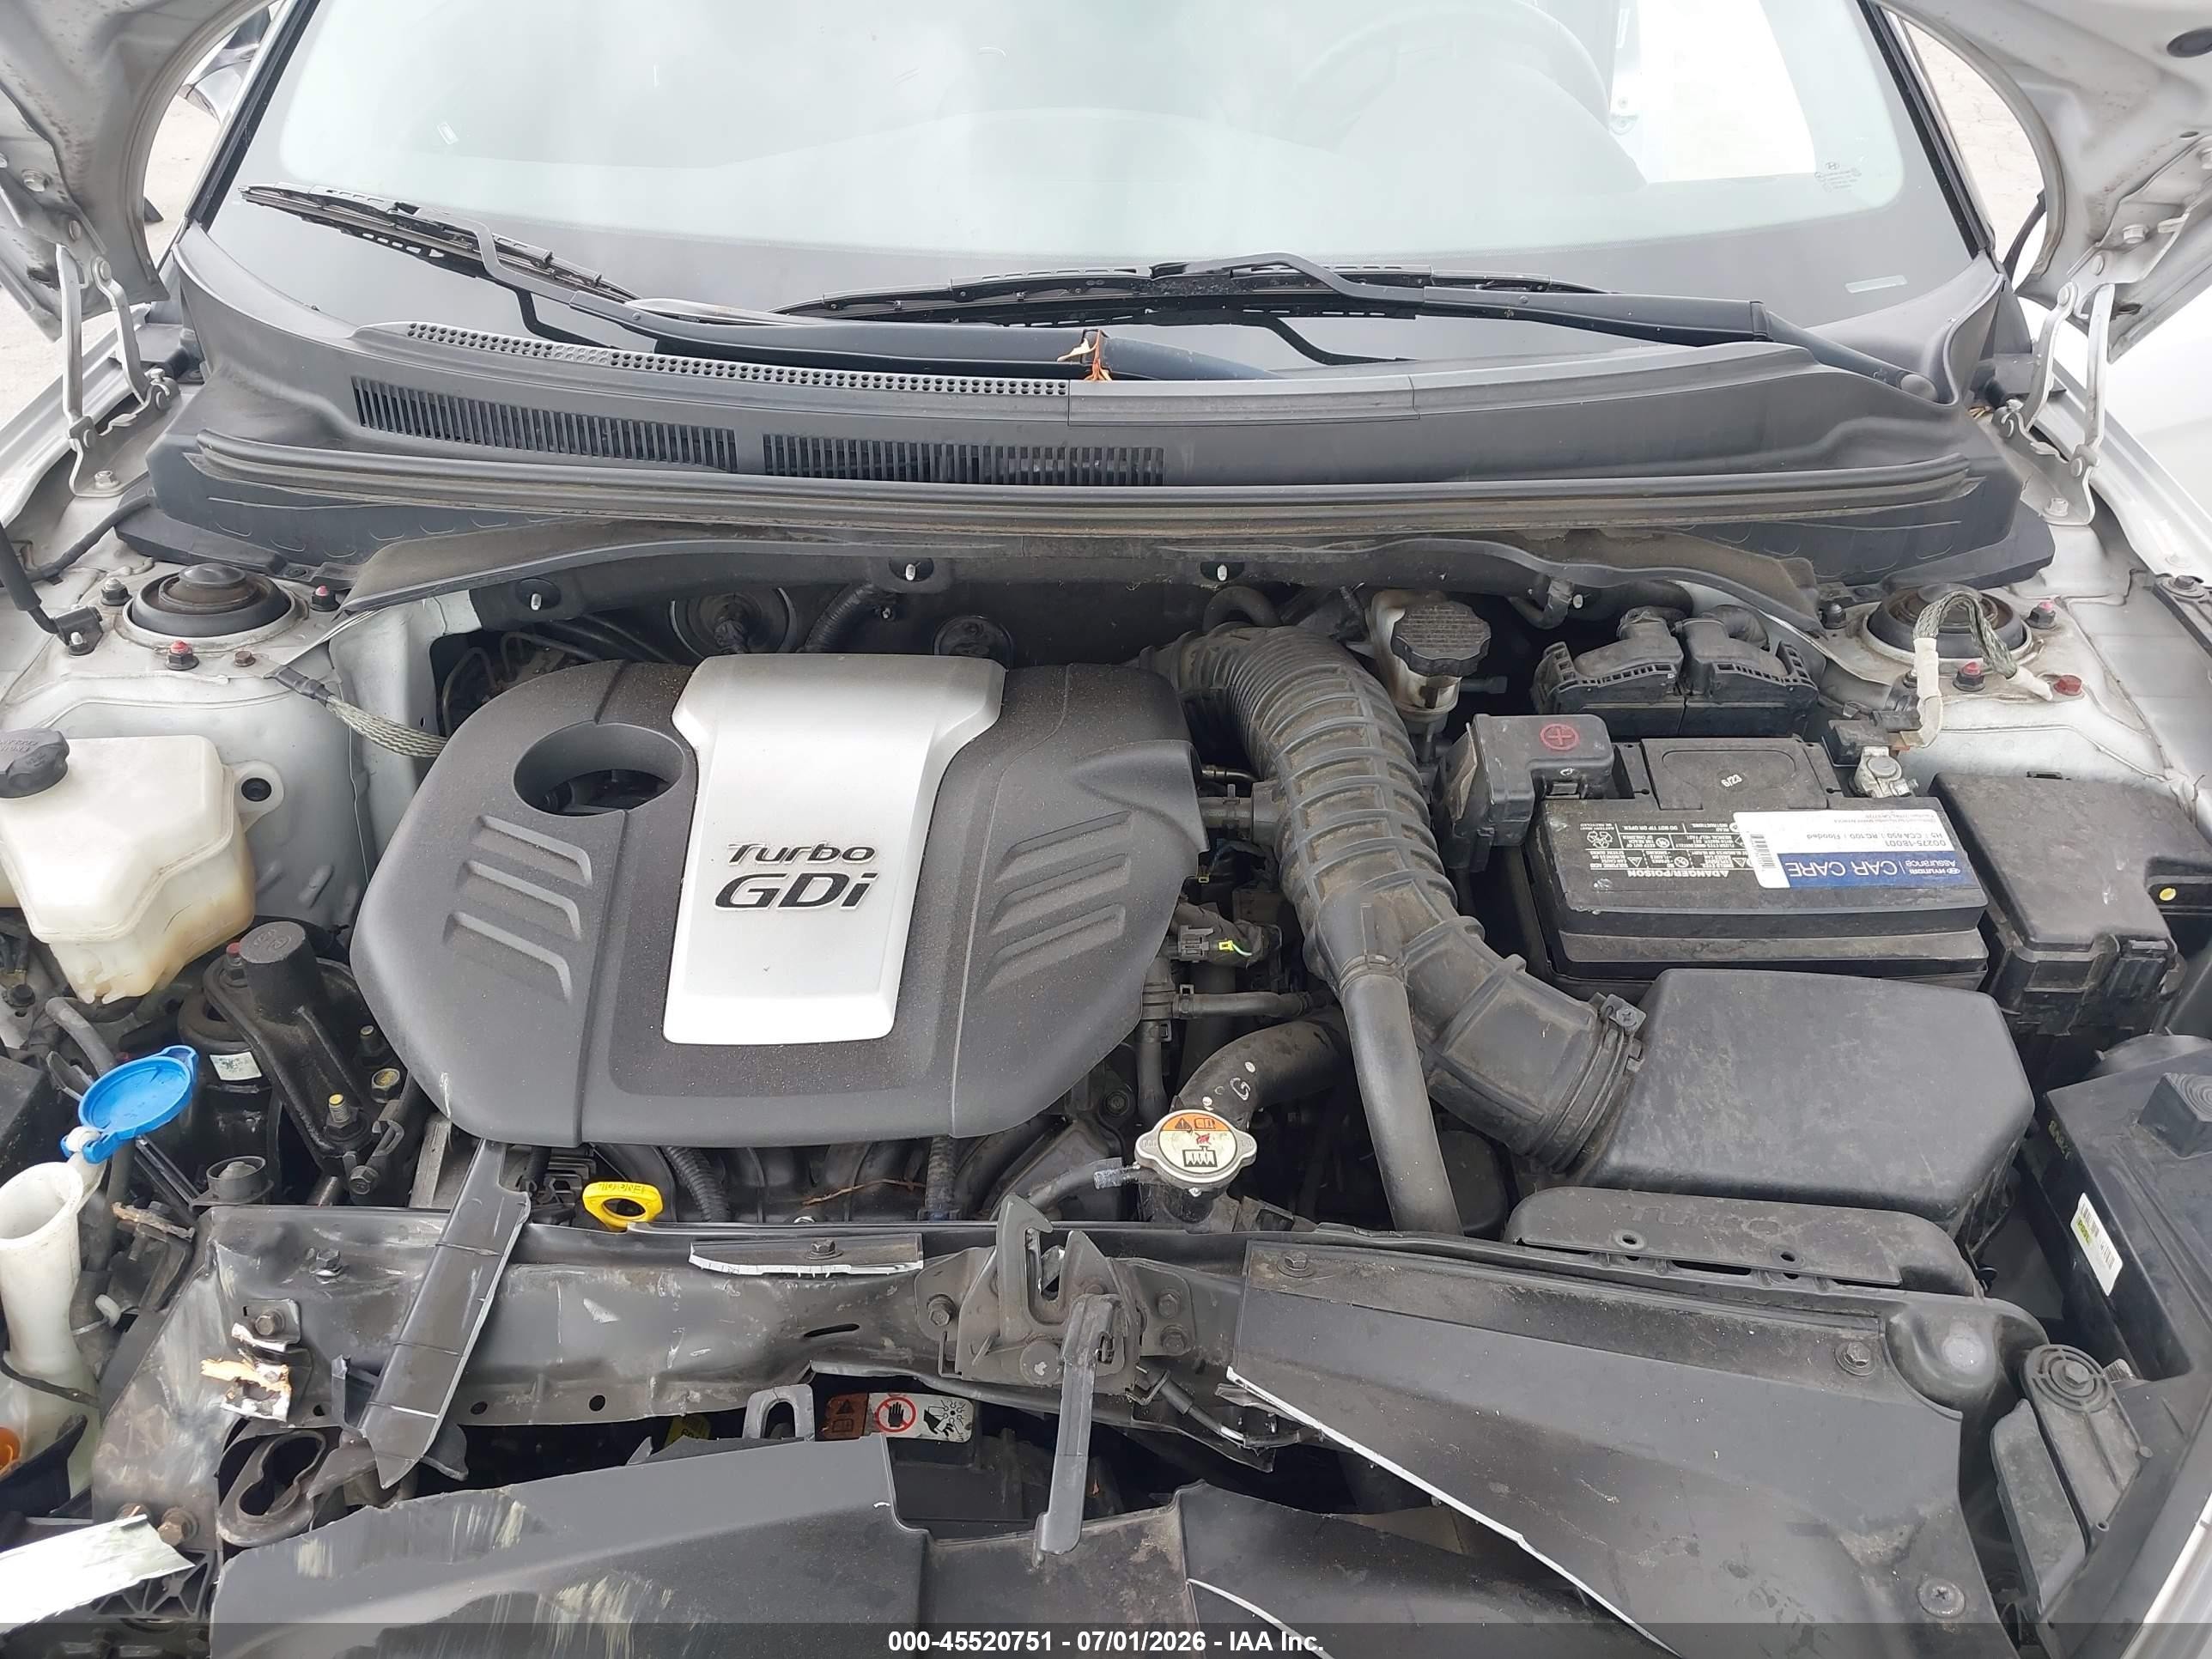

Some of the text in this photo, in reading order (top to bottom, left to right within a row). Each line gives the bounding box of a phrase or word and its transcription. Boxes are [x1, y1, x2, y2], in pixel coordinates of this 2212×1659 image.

[1721, 774, 1742, 787] 6/23
[728, 842, 877, 865] Turbo
[1785, 860, 1898, 877] CAR CARE
[715, 872, 879, 909] GDi
